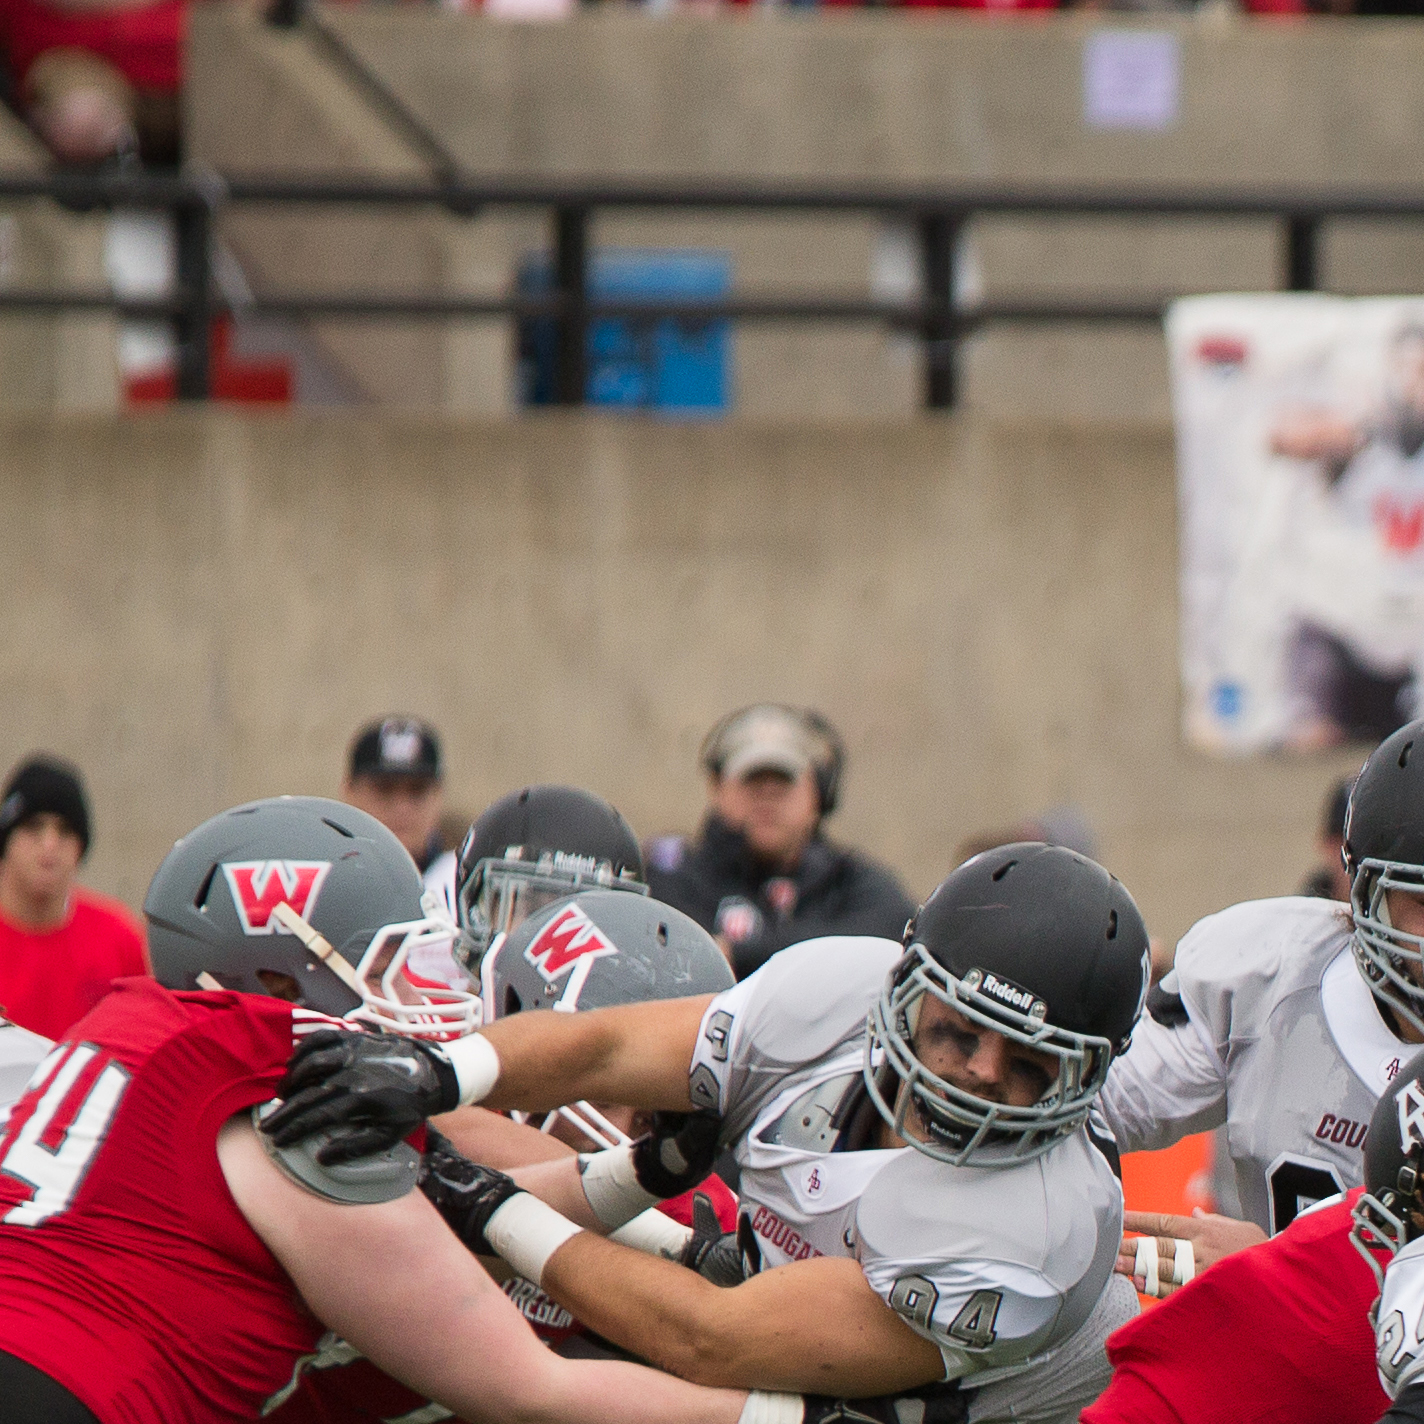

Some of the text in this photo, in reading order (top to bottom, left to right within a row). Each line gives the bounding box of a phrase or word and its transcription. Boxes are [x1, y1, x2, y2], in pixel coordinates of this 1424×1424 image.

[222, 860, 333, 936] W
[523, 902, 618, 983] W
[983, 974, 1034, 1010] Riddell
[1315, 1113, 1368, 1151] COU
[752, 1206, 825, 1262] COUGA
[888, 1273, 1004, 1349] 94
